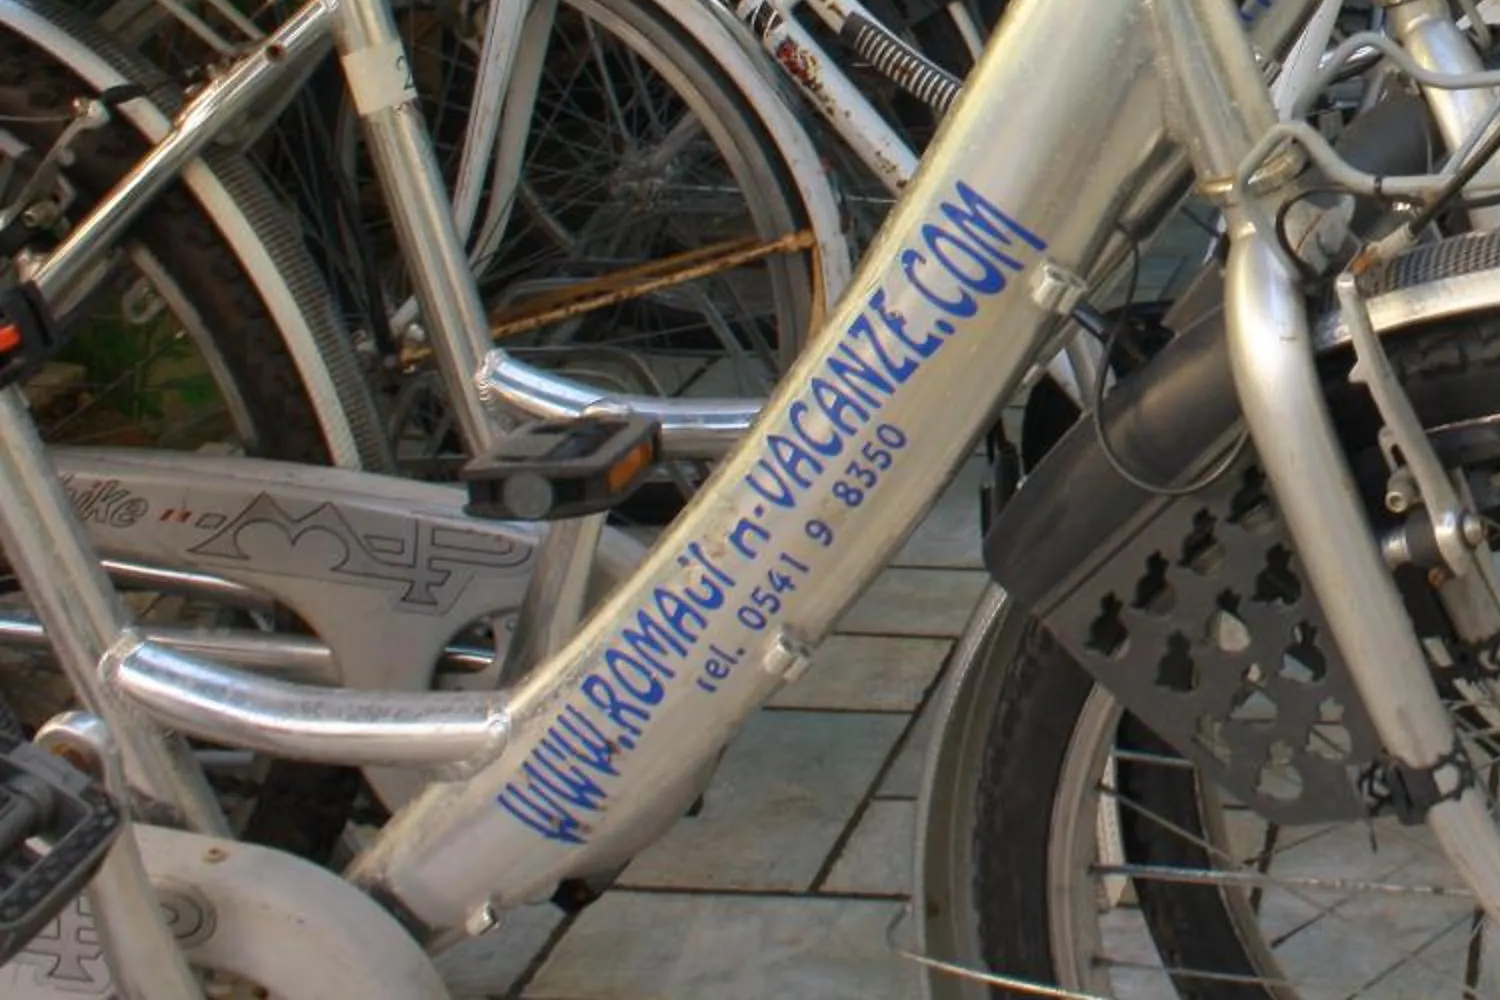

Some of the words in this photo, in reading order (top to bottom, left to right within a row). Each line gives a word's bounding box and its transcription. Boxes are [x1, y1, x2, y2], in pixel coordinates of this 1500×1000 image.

[737, 552, 810, 631] 0541
[805, 518, 834, 547] 9
[832, 423, 908, 507] 8350
